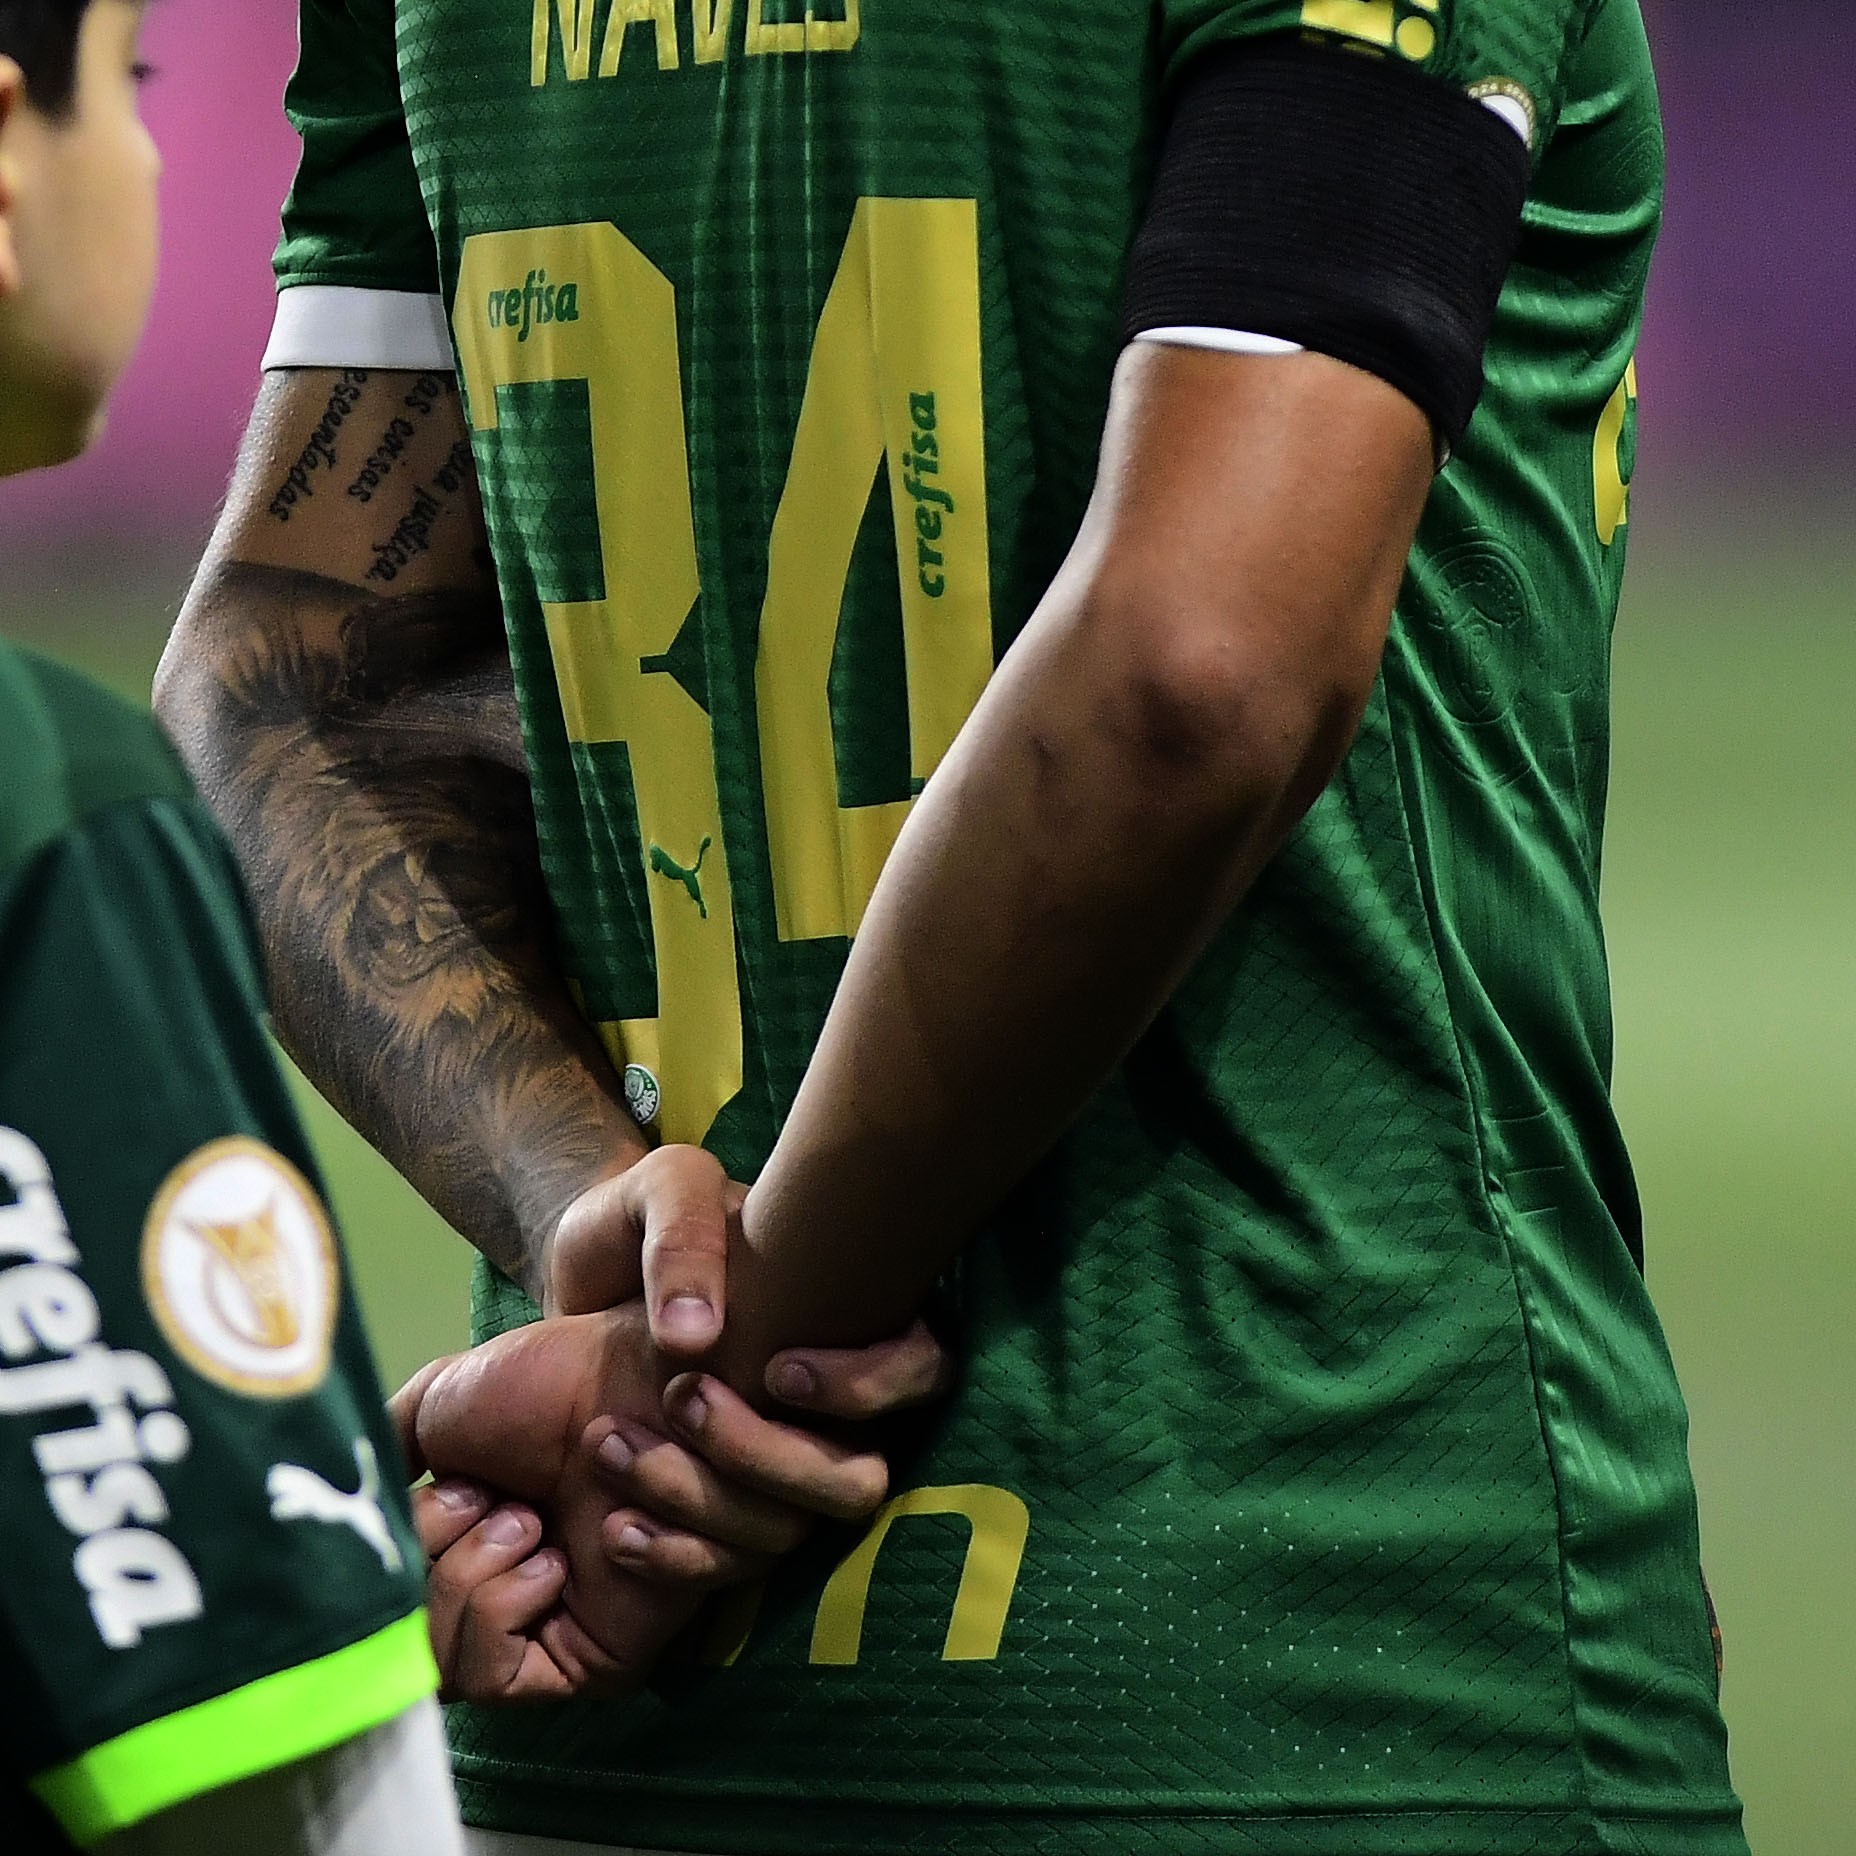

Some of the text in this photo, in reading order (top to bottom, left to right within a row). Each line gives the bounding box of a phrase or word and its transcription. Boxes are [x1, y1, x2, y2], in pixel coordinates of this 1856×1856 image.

[488, 267, 580, 343] crefisa
[900, 390, 955, 600] crefisa
[454, 196, 994, 1147] 34
